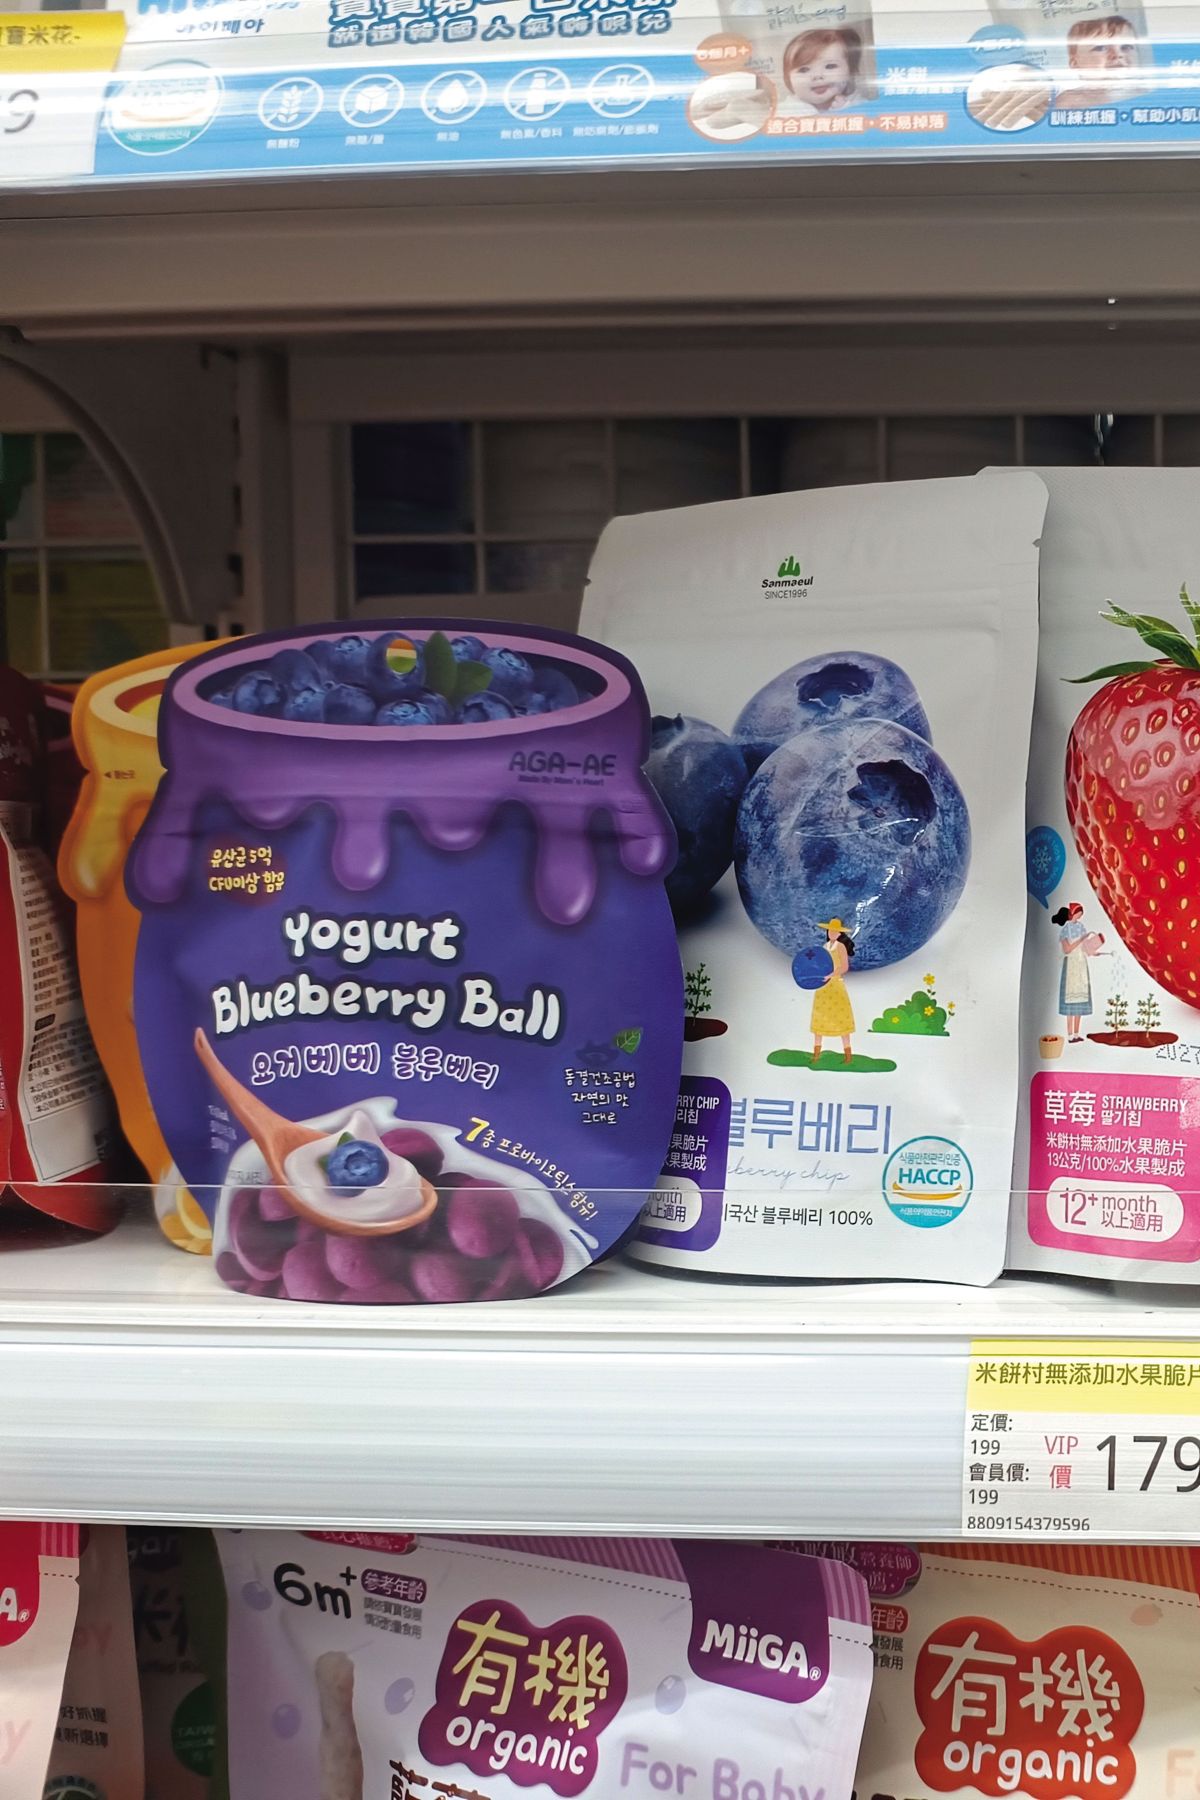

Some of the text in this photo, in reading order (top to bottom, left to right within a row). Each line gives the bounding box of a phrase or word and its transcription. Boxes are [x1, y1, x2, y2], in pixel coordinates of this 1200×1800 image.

[0, 25, 81, 45] 寶米花-
[761, 576, 814, 588] Sanmaeul
[508, 750, 617, 776] AGA-AE
[210, 846, 247, 869] 유산균
[208, 870, 285, 894] CFU이상 함유
[285, 912, 460, 963] Yogurt
[212, 973, 560, 1040] Blueberry Ball
[251, 1042, 499, 1090] 요거베베 블루베리
[563, 1068, 636, 1088] 동결건조공법
[571, 1091, 630, 1107] 자연의 맛
[697, 1096, 720, 1110] CHIP
[1044, 1090, 1096, 1127] 草莓
[1101, 1096, 1188, 1113] STRAWBERRY
[582, 1111, 617, 1125] 그대로
[1101, 1111, 1142, 1127] 딸기칩
[1046, 1131, 1188, 1157] 米餅村無添加水果脆片
[728, 1155, 850, 1191] berry chip
[898, 1167, 961, 1185] HACCP
[1047, 1152, 1185, 1178] 13公克/100%水果製成
[1102, 1195, 1157, 1213] month
[762, 1206, 823, 1227] 블루베리
[829, 1210, 873, 1226] 100%
[1101, 1210, 1163, 1232] 以上適用
[971, 1413, 1013, 1432] 定價:
[971, 1439, 1001, 1455] 199
[1045, 1435, 1079, 1455] VIP
[968, 1463, 1030, 1482] 會員價:
[1049, 1465, 1072, 1489] 價
[968, 1489, 999, 1505] 199
[967, 1516, 1090, 1531] 8809154379596
[700, 1619, 808, 1678] MiiGA
[453, 1611, 611, 1729] 有機
[928, 1631, 1120, 1742] 有機
[446, 1716, 588, 1775] organic
[620, 1742, 826, 1800] For Baby
[943, 1739, 1118, 1790] organic
